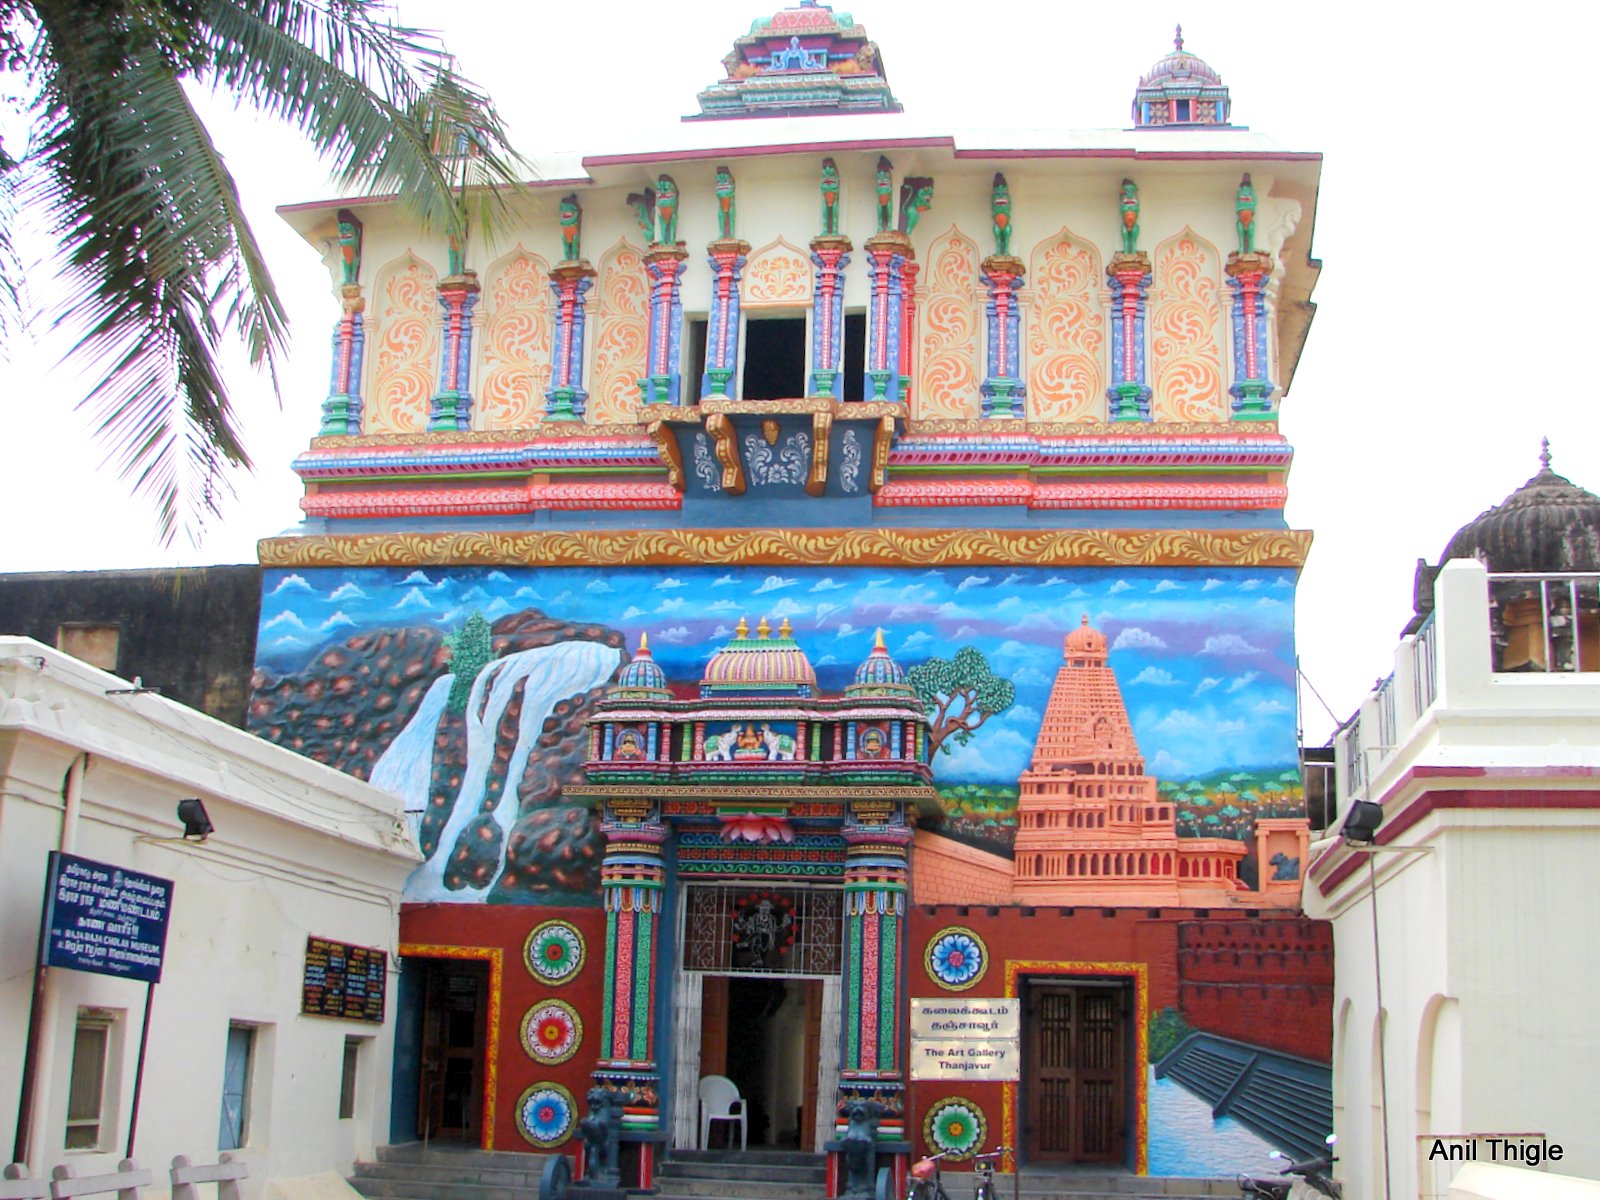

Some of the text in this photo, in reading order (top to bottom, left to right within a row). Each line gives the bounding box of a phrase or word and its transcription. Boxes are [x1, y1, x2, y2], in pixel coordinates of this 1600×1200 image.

[65, 929, 84, 940] RAJA
[84, 932, 103, 943] RAJA
[922, 1006, 1008, 1015] கலைக்கூடம்
[931, 1020, 998, 1031] தஞ்சாவூர்
[924, 1048, 1006, 1058] The Art Gallery
[938, 1061, 991, 1071] Thanjavur
